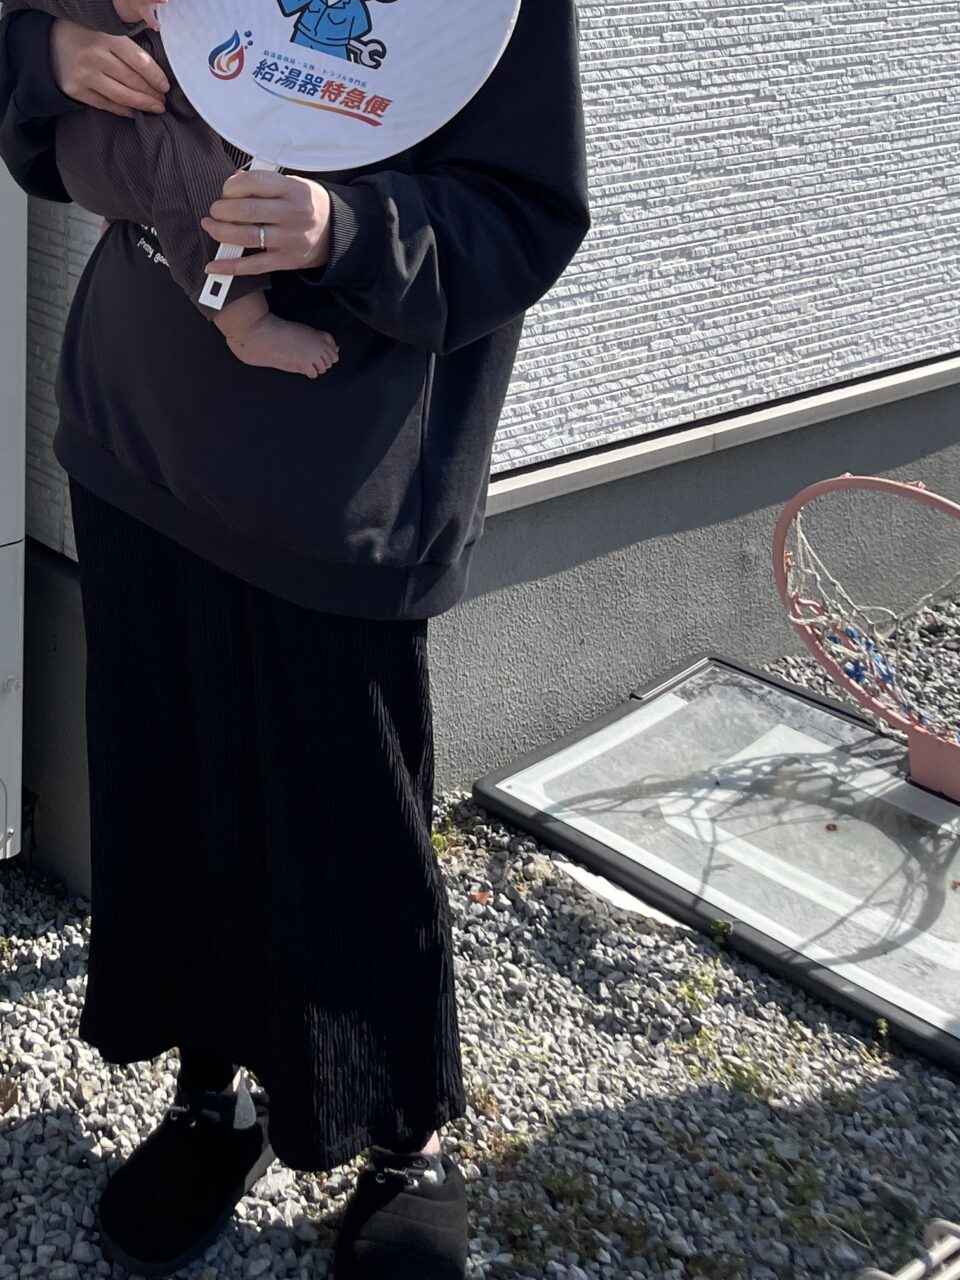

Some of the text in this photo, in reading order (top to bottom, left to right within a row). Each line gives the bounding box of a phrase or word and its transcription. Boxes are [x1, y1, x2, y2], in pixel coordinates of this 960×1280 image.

[252, 58, 393, 118] 給湯器特急便
